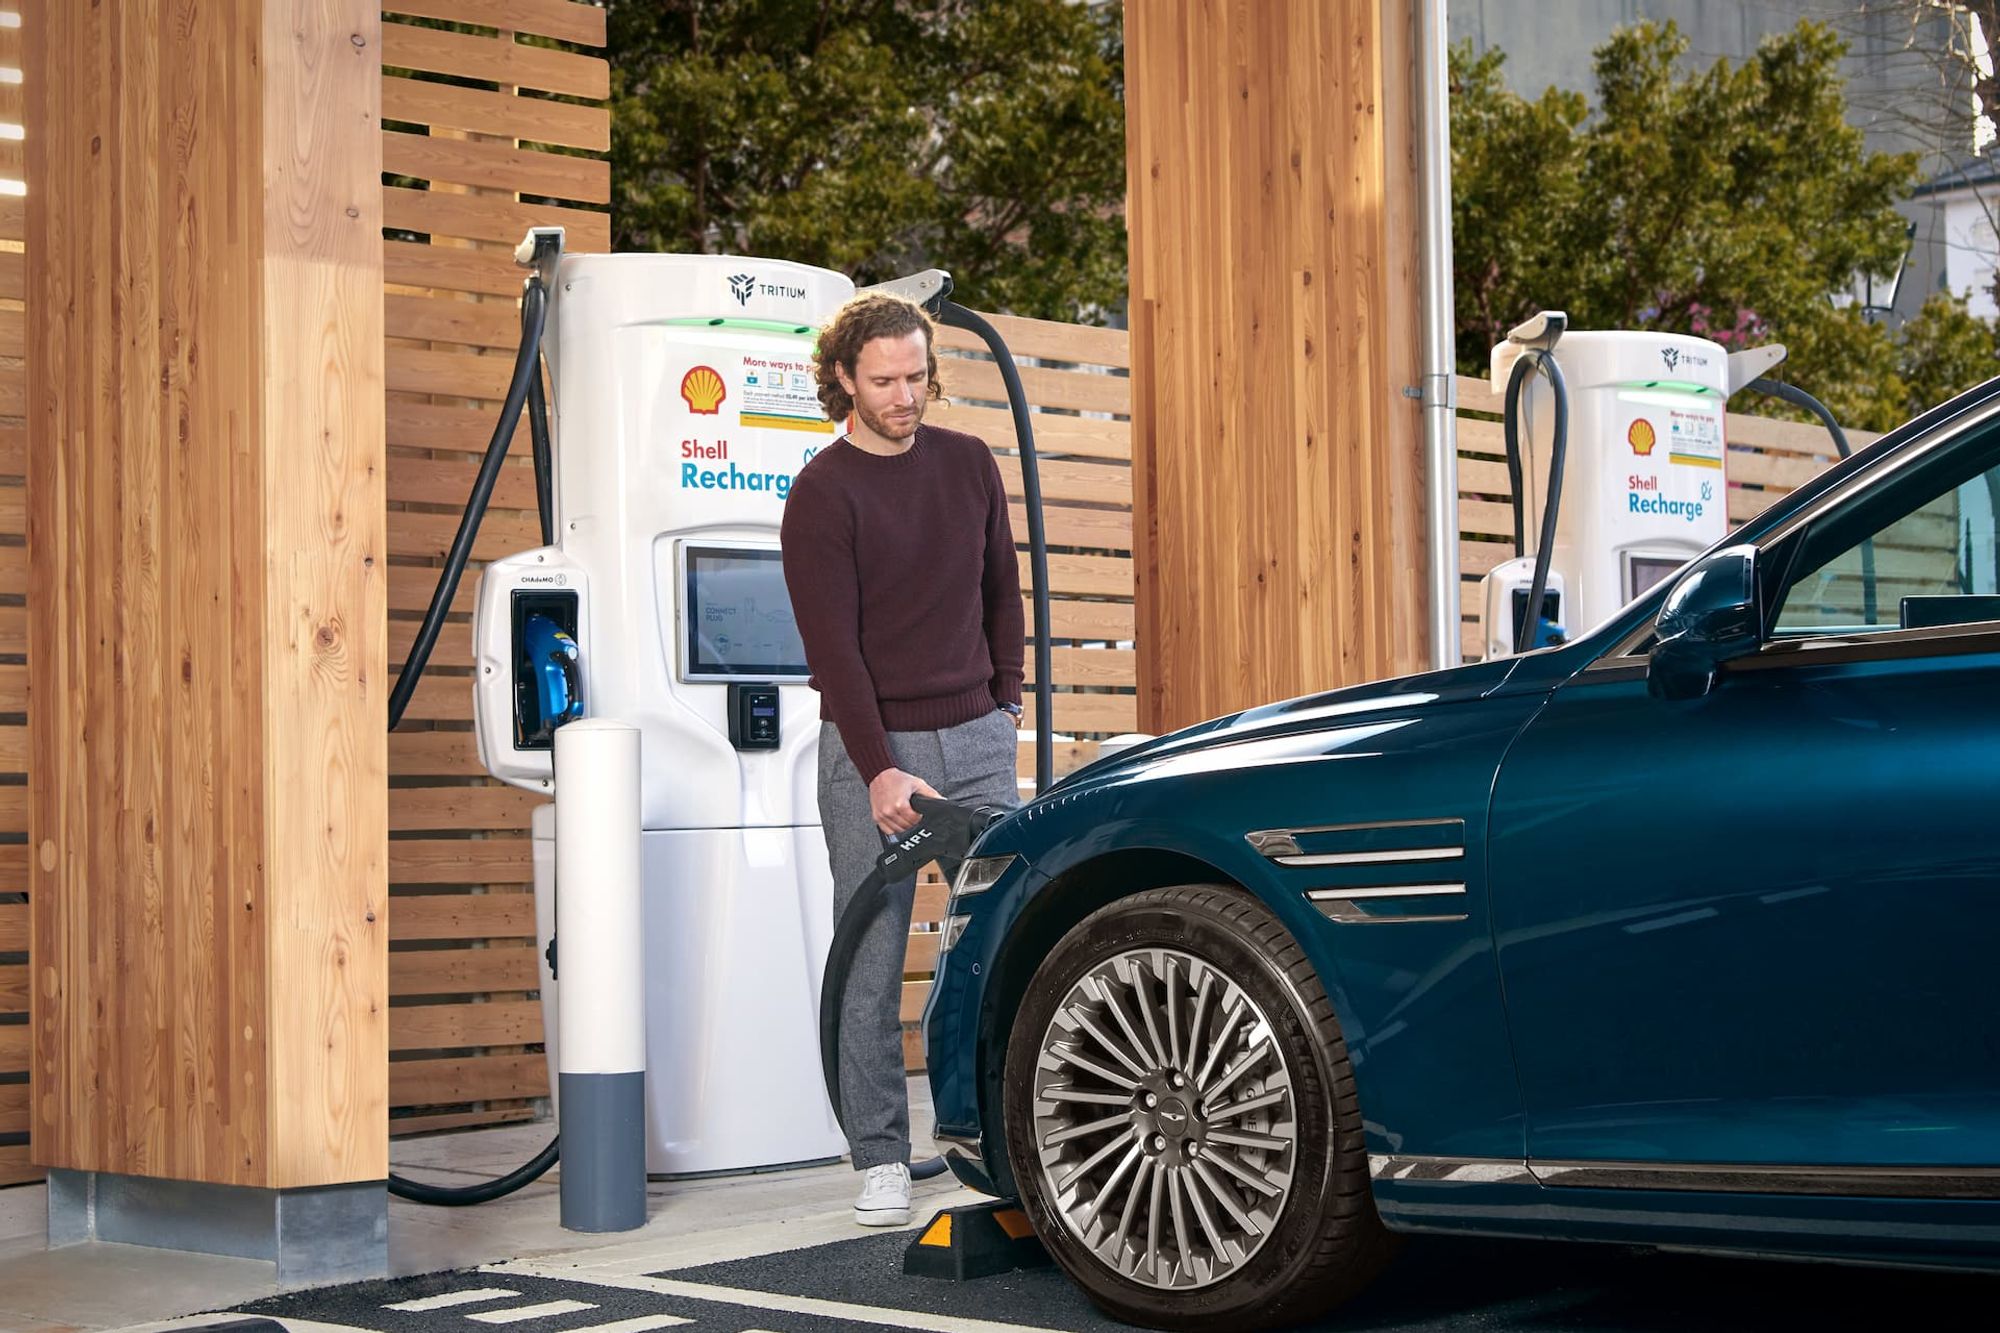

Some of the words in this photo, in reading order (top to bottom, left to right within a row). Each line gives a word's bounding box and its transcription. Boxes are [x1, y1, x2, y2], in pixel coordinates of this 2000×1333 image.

[760, 284, 806, 299] TRITIUM
[743, 357, 767, 368] More
[769, 361, 793, 372] ways
[795, 362, 804, 371] to
[1682, 355, 1708, 366] TRITIUM
[681, 439, 728, 460] Shell
[681, 462, 797, 500] Recharg
[1629, 475, 1657, 490] Shell
[1629, 492, 1703, 522] Recharge
[900, 829, 932, 851] HPC
